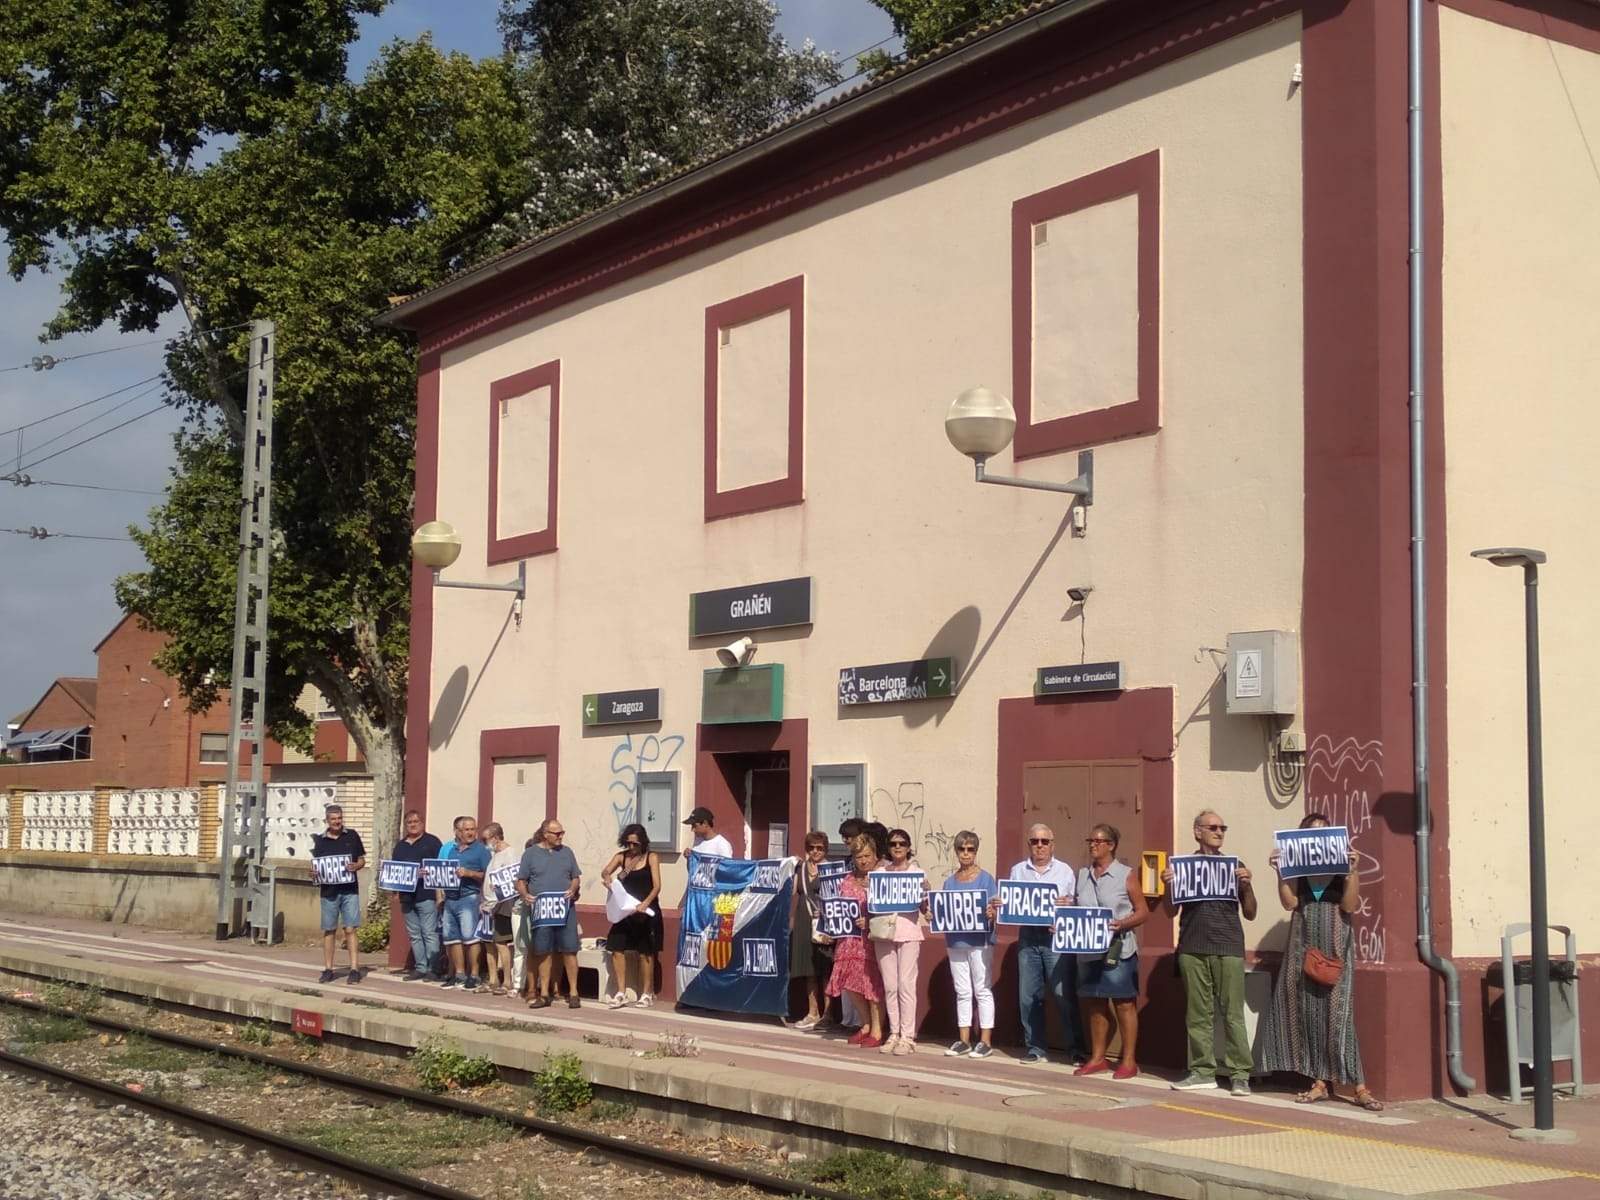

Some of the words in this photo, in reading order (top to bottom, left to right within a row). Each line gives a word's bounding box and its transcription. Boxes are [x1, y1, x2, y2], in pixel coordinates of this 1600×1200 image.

[730, 594, 772, 618] GRAÑÉN
[859, 676, 907, 692] Barcelona
[1044, 675, 1071, 685] Gabinete
[1073, 674, 1081, 682] de
[1082, 671, 1117, 682] Circulación
[612, 701, 644, 716] Zaragoza
[868, 877, 923, 905] ALCUBIERRE
[1172, 861, 1237, 898] VALFONDA
[934, 892, 985, 931] CURBE
[1001, 886, 1058, 917] PIRACES
[1055, 911, 1110, 949] GRAÑÉN
